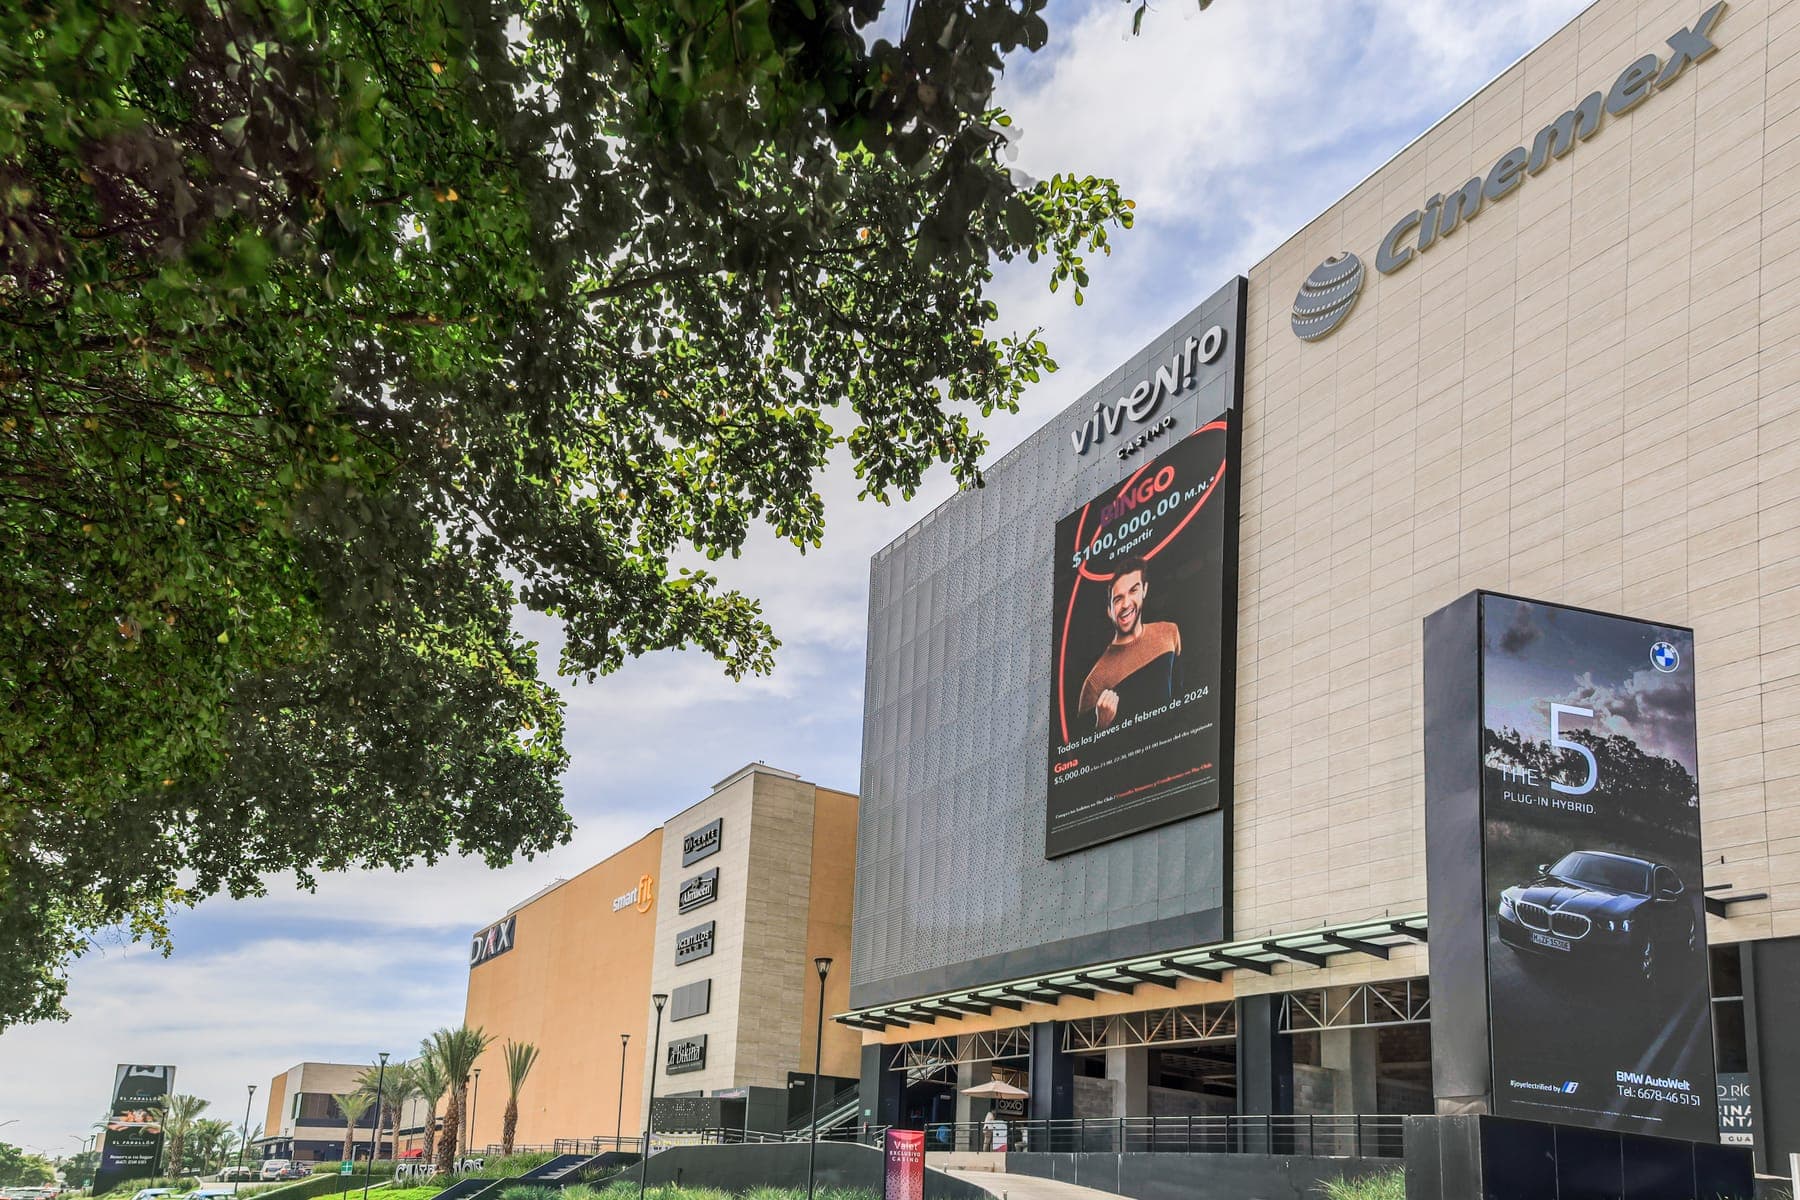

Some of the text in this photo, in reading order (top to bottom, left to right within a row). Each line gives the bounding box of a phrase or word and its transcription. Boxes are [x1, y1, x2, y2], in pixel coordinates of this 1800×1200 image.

[1116, 415, 1173, 459] CASINO
[1100, 465, 1175, 527] BINGO
[1072, 491, 1181, 569] $100,000.00
[1116, 528, 1153, 556] repartir
[1057, 685, 1209, 755] Todos los jueves de febrero de 2024
[1500, 702, 1598, 795] THE 5
[1053, 765, 1090, 785] $5,000.00
[1054, 758, 1079, 774] Gana
[1503, 791, 1549, 808] PLUG-IN
[636, 874, 654, 913] fit
[1616, 1070, 1691, 1091] BMW AutoWelt
[1616, 1085, 1701, 1106] Tel.: 6678-46 51 51
[893, 1140, 919, 1151] Valet
